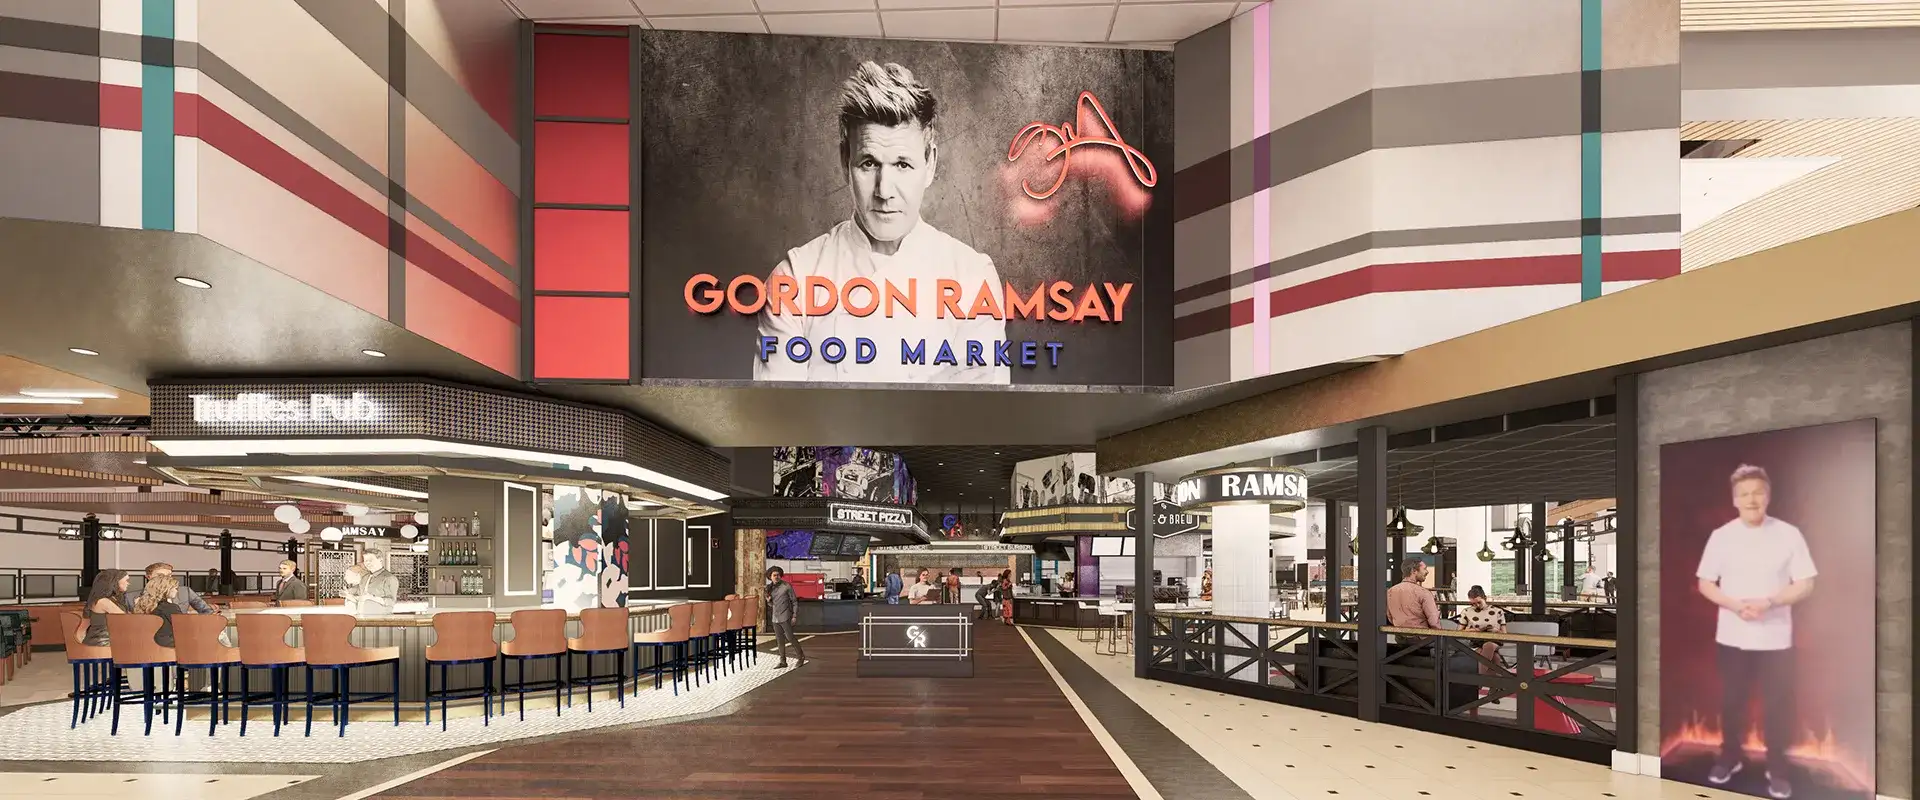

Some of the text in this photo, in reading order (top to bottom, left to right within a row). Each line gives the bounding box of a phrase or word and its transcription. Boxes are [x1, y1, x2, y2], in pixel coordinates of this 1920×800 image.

[683, 273, 1133, 322] GORDON RAMSAY
[760, 336, 1064, 367] FOOD MARKET
[310, 392, 374, 421] Pub
[837, 508, 906, 524] STREET PIZZA
[1169, 514, 1193, 525] BREW
